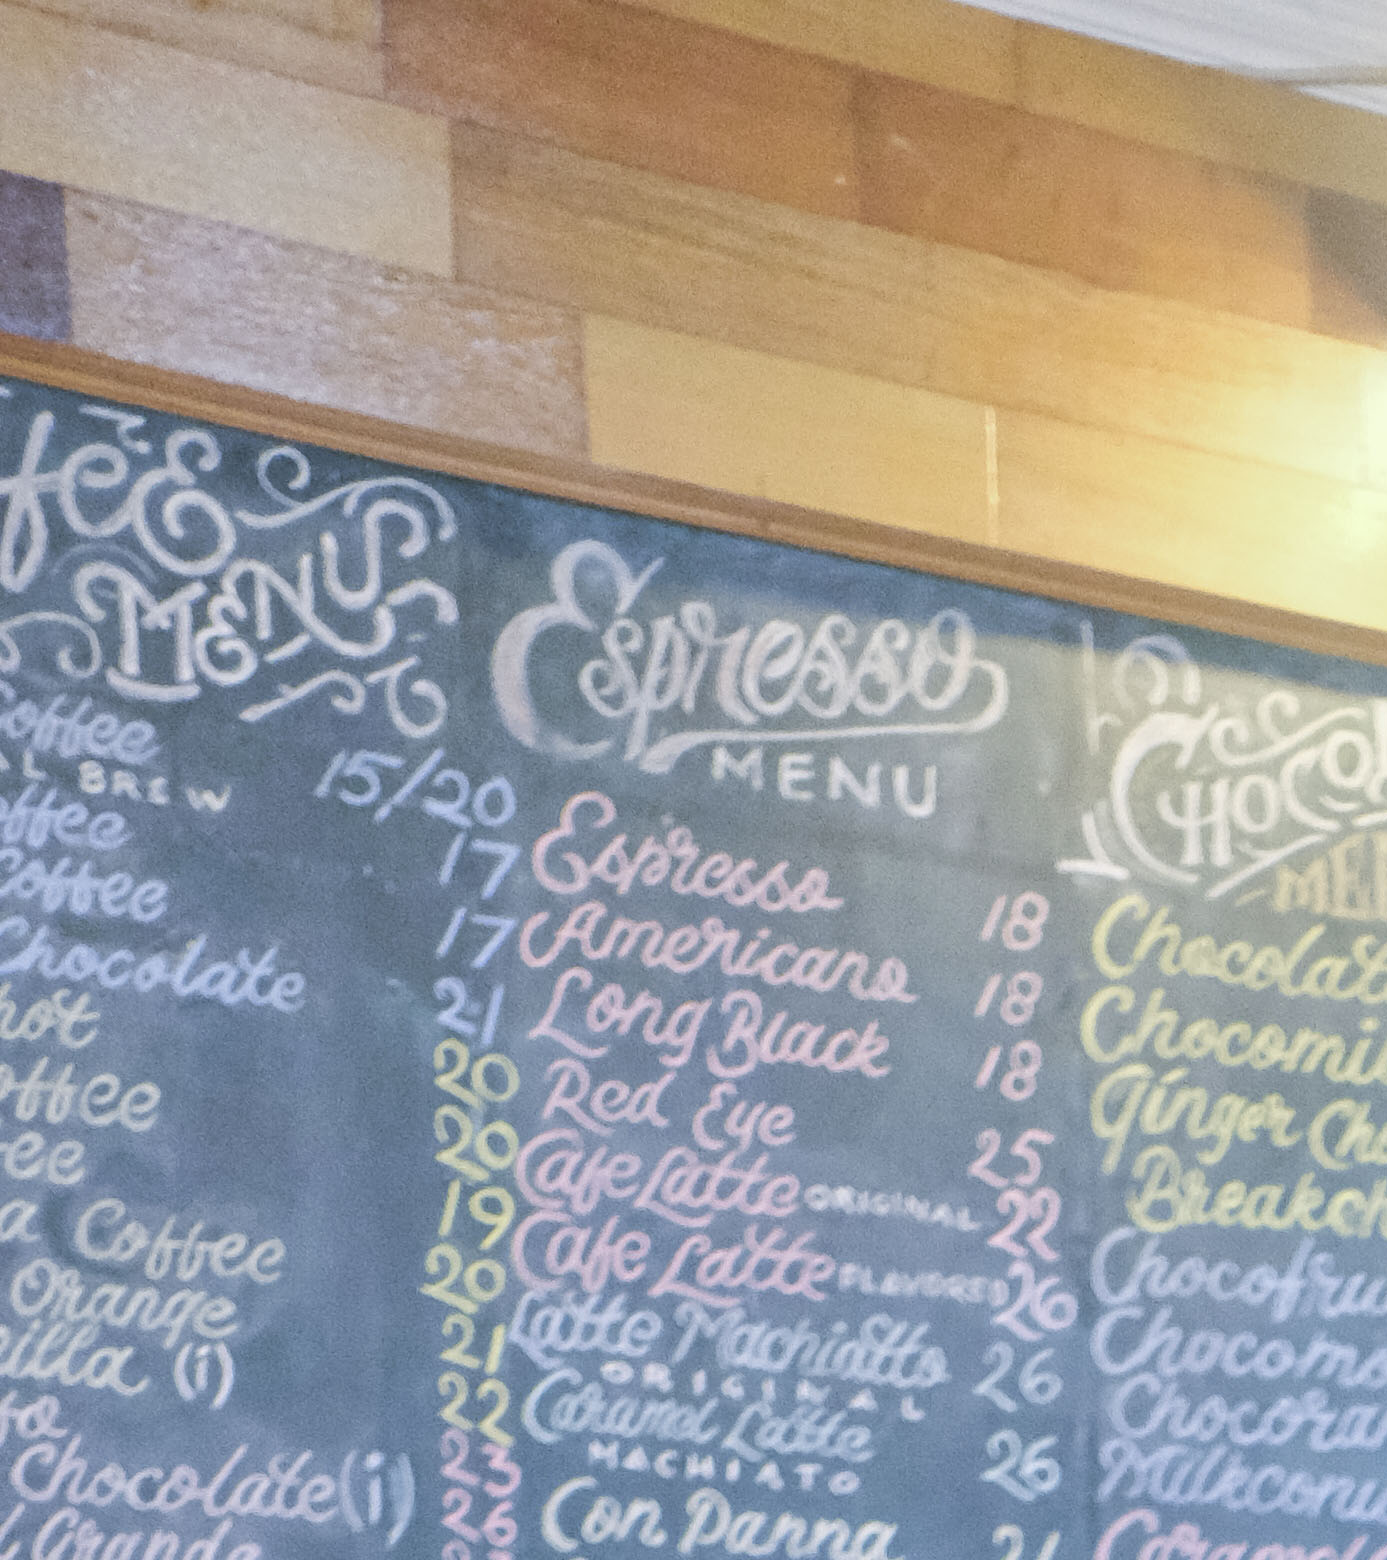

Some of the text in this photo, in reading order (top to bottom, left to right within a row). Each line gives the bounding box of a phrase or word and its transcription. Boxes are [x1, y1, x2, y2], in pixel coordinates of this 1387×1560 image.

[490, 539, 1009, 775] Espresso
[315, 748, 517, 826] 15/20
[709, 745, 938, 819] MENU
[438, 832, 520, 899] 17
[531, 791, 1051, 952] Espresso 18
[436, 908, 517, 969] 17
[518, 900, 1043, 1027] Americano 18
[432, 976, 505, 1046] 21
[528, 965, 1043, 1101] Long Black 18
[432, 1037, 521, 1113] 20
[432, 1104, 519, 1182] 20
[542, 1057, 1056, 1187] Red Eye 25
[437, 1178, 516, 1251] 19
[514, 1128, 644, 1215] Cafe
[634, 1146, 802, 1228] Latte
[987, 1186, 1062, 1262] 22
[73, 1198, 287, 1284] Coffee
[418, 1243, 507, 1314] 20
[509, 1209, 652, 1294] Cafe
[648, 1223, 837, 1309] Latte
[992, 1260, 1080, 1342] 26
[440, 1313, 507, 1374] 21
[509, 1290, 663, 1370] Latte
[973, 1341, 1065, 1414] 26
[437, 1371, 516, 1447] 22
[440, 1428, 523, 1498] 23
[722, 1401, 877, 1463] Latte
[980, 1428, 1064, 1502] 26
[441, 1488, 518, 1547] 26
[541, 1475, 669, 1554] Con
